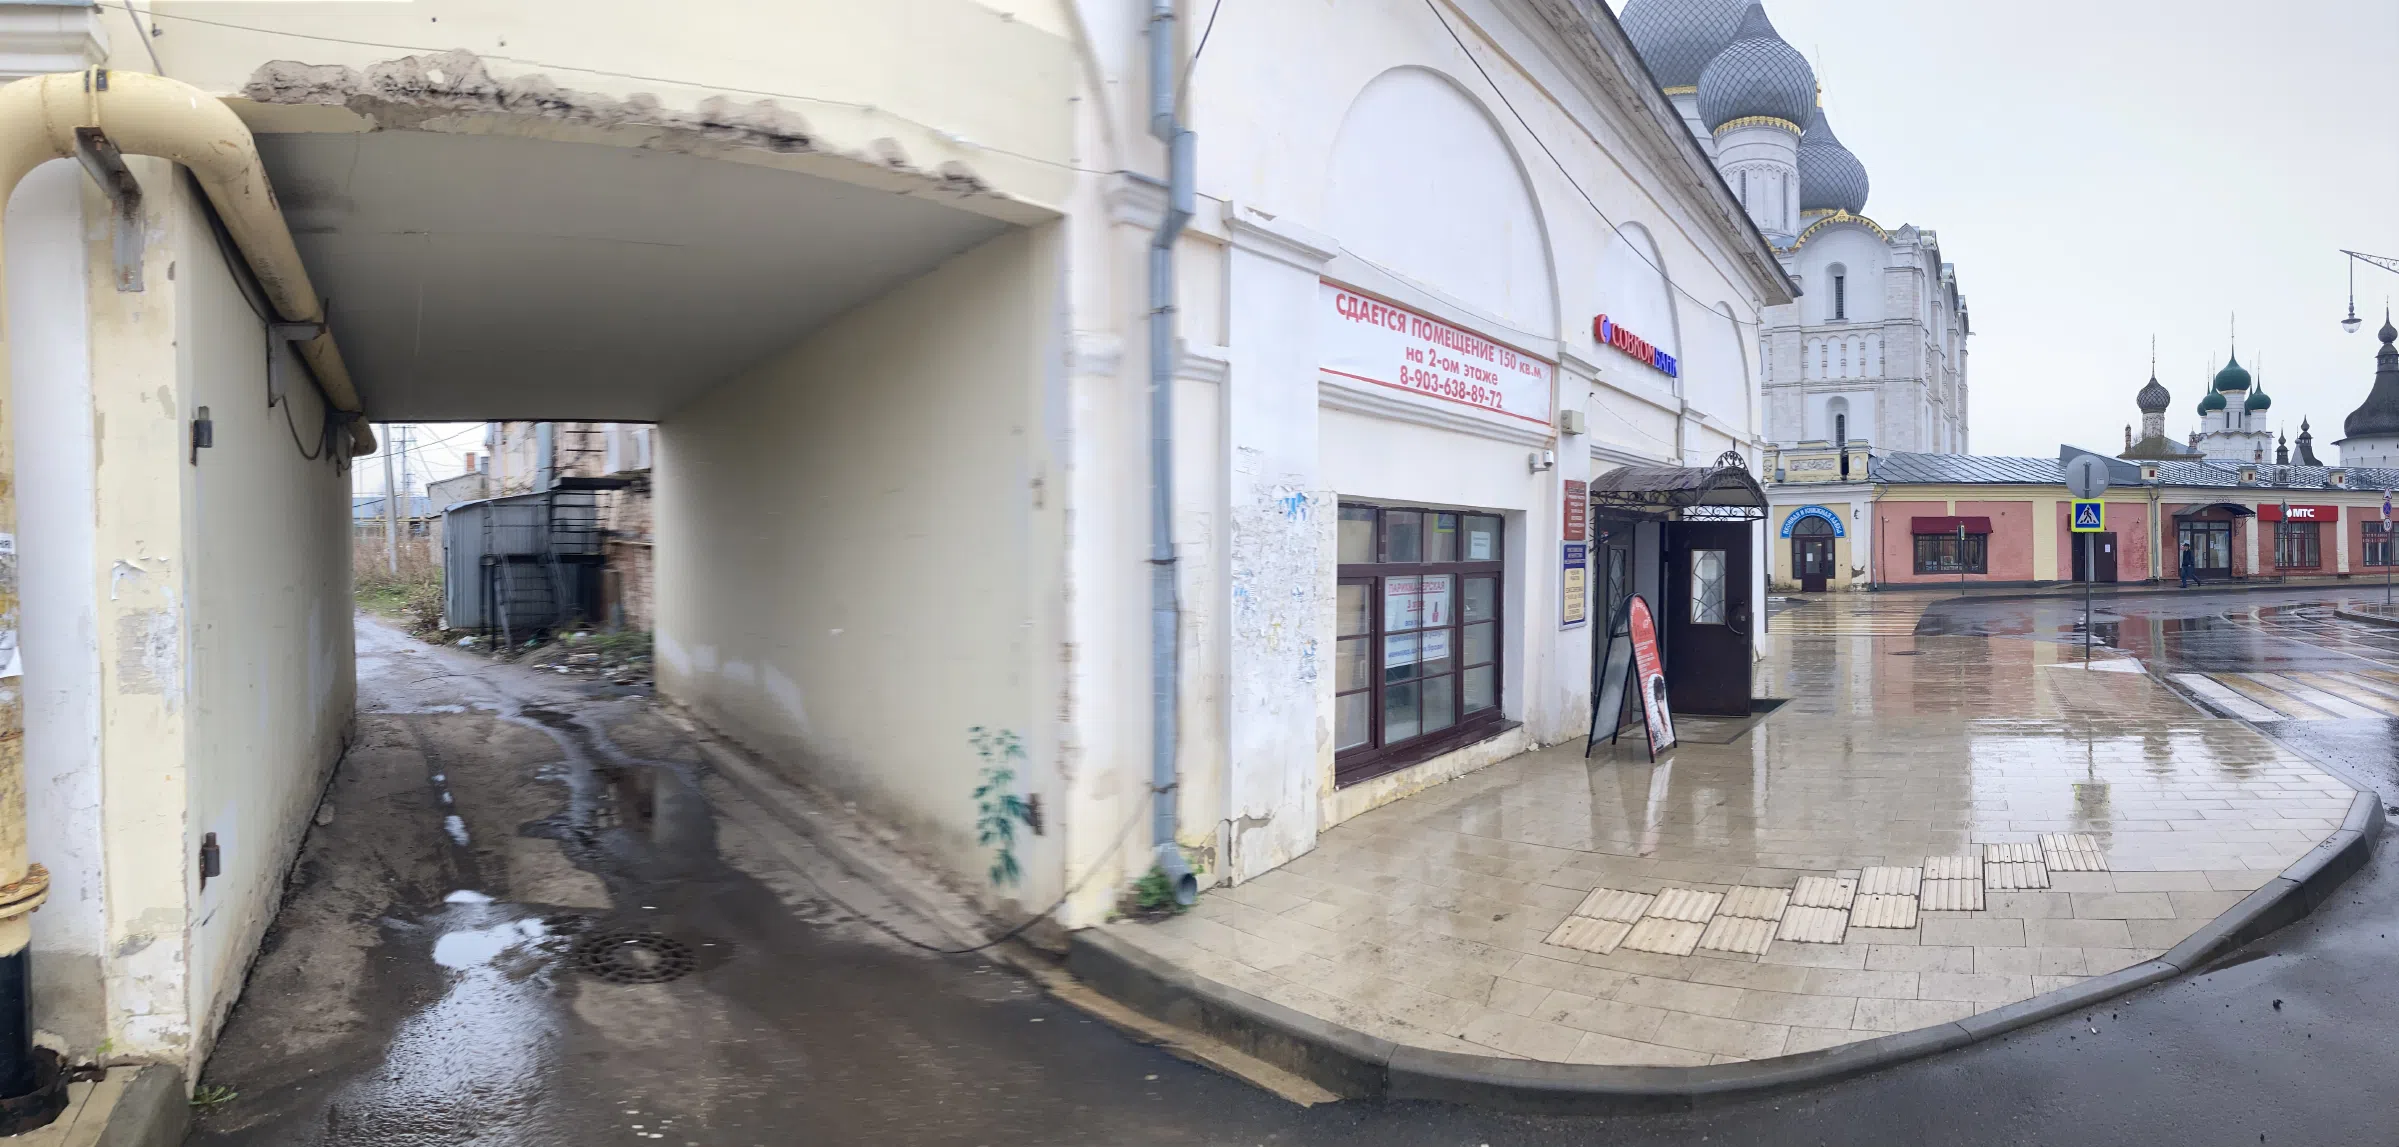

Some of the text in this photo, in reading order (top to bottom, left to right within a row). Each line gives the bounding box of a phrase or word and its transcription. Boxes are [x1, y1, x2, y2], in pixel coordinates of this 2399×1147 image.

[1335, 292, 1407, 334] СДАЕТСЯ
[1411, 317, 1495, 363] ПОМЕЩЕНИЕ
[1499, 348, 1517, 370] 150
[1610, 323, 1678, 379] СОВКОМБАНК
[1399, 364, 1503, 410] 8-903-638-89-72
[1405, 346, 1499, 387] на 2-ом этаже
[2292, 508, 2315, 518] МТС
